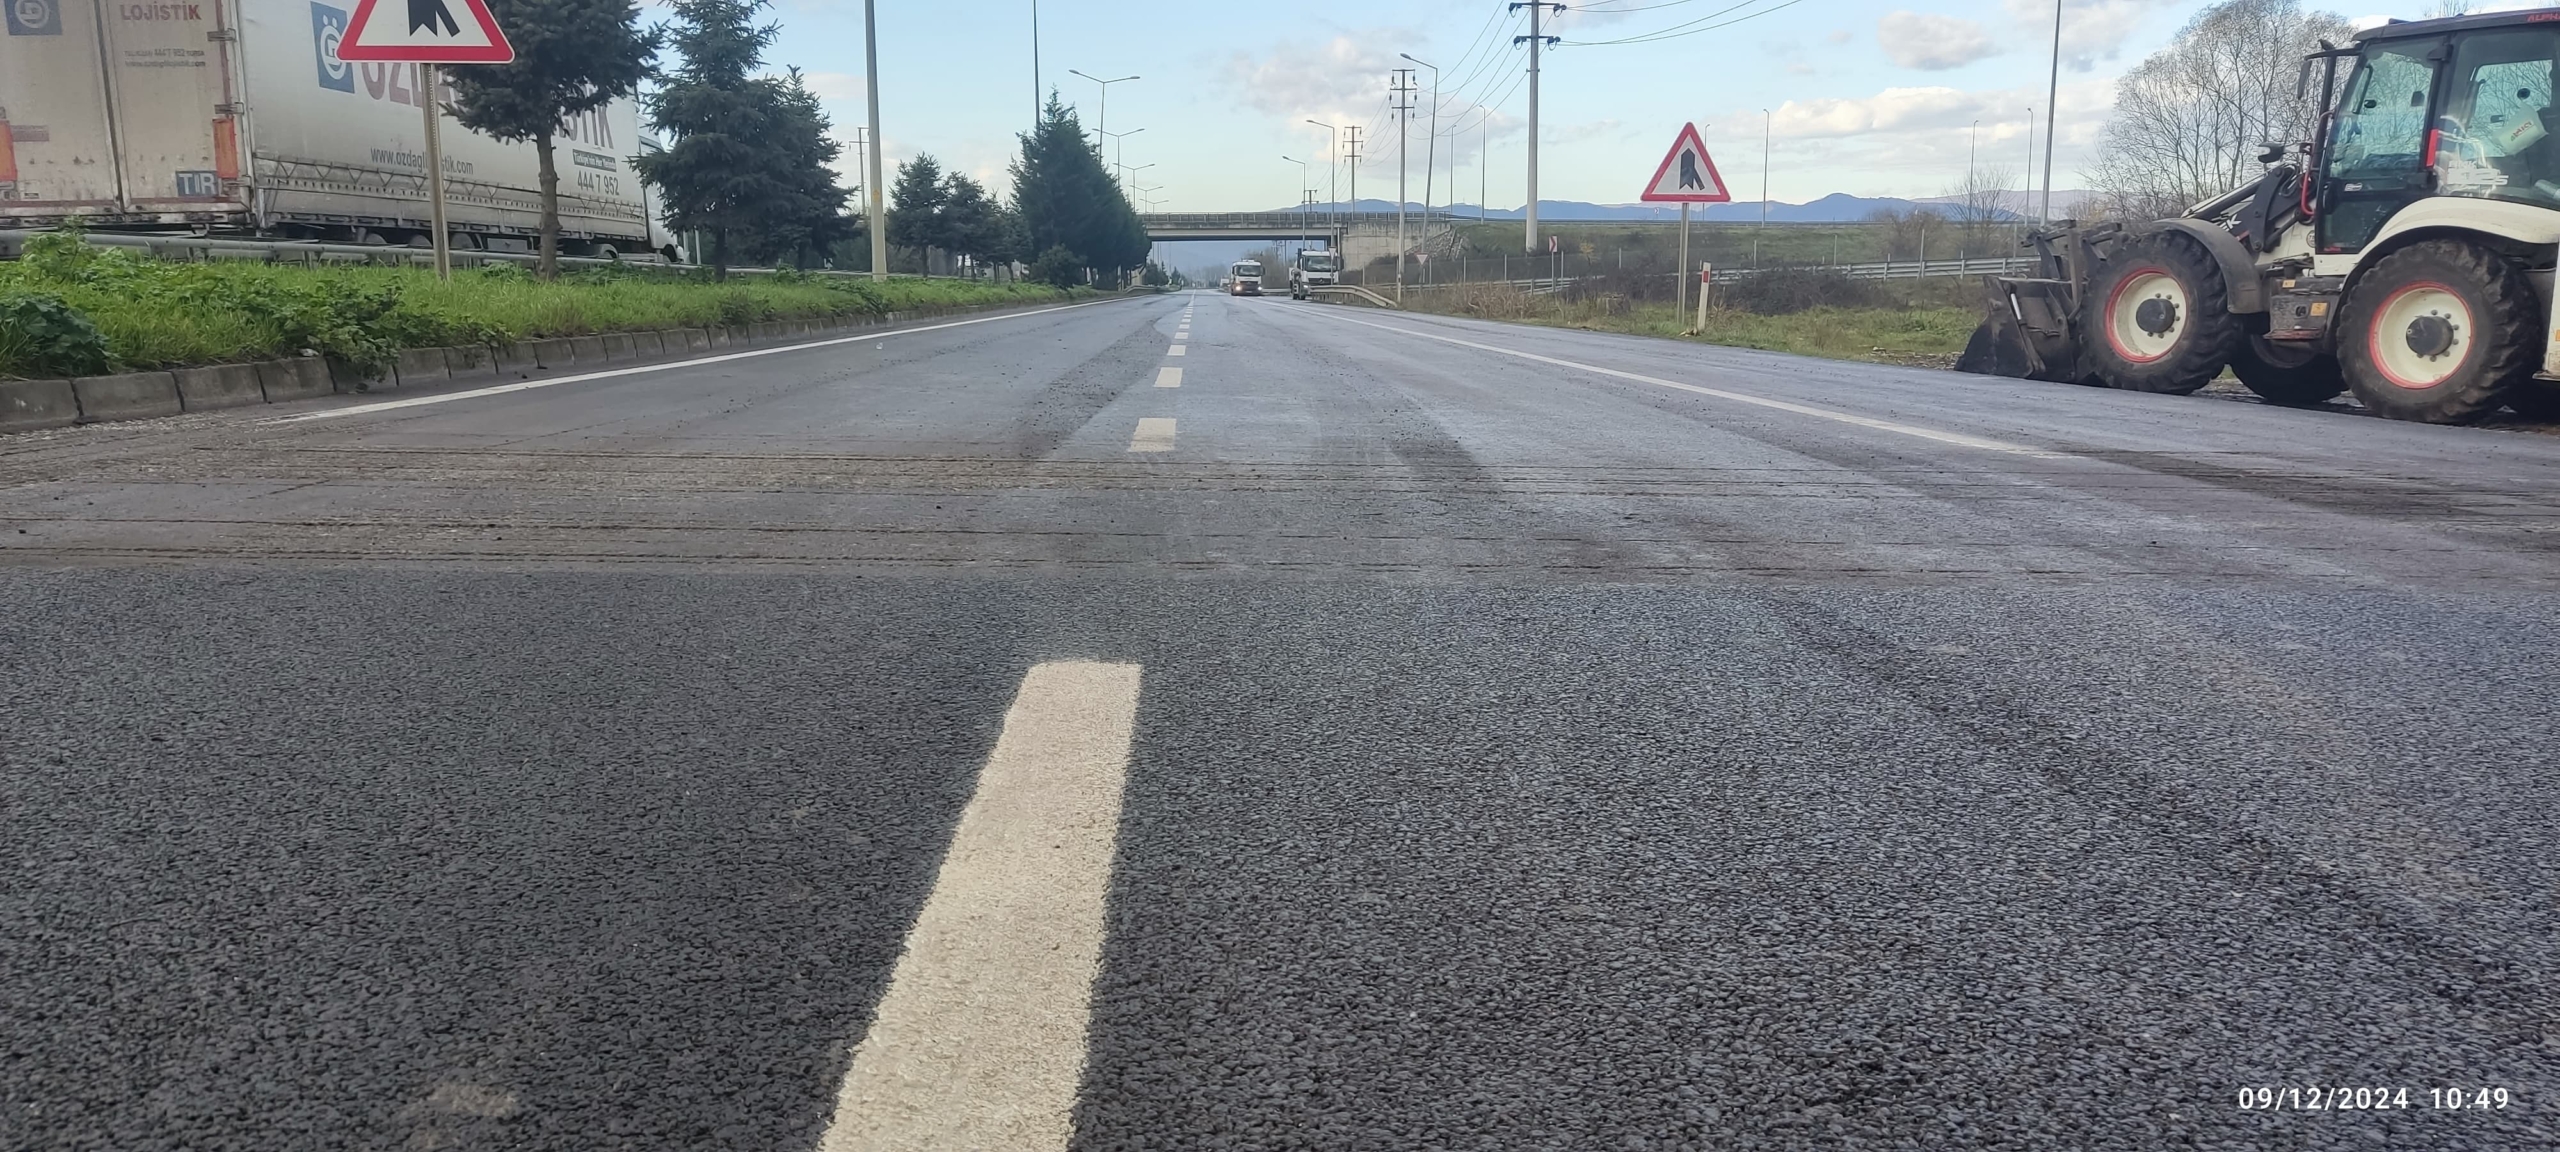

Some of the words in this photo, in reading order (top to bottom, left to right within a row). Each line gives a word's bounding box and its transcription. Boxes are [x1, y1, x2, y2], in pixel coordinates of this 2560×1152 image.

[120, 1, 202, 20] LOJİSTİK
[178, 173, 216, 195] TIR
[577, 170, 594, 192] 444
[595, 173, 601, 193] 7
[603, 174, 620, 196] 952
